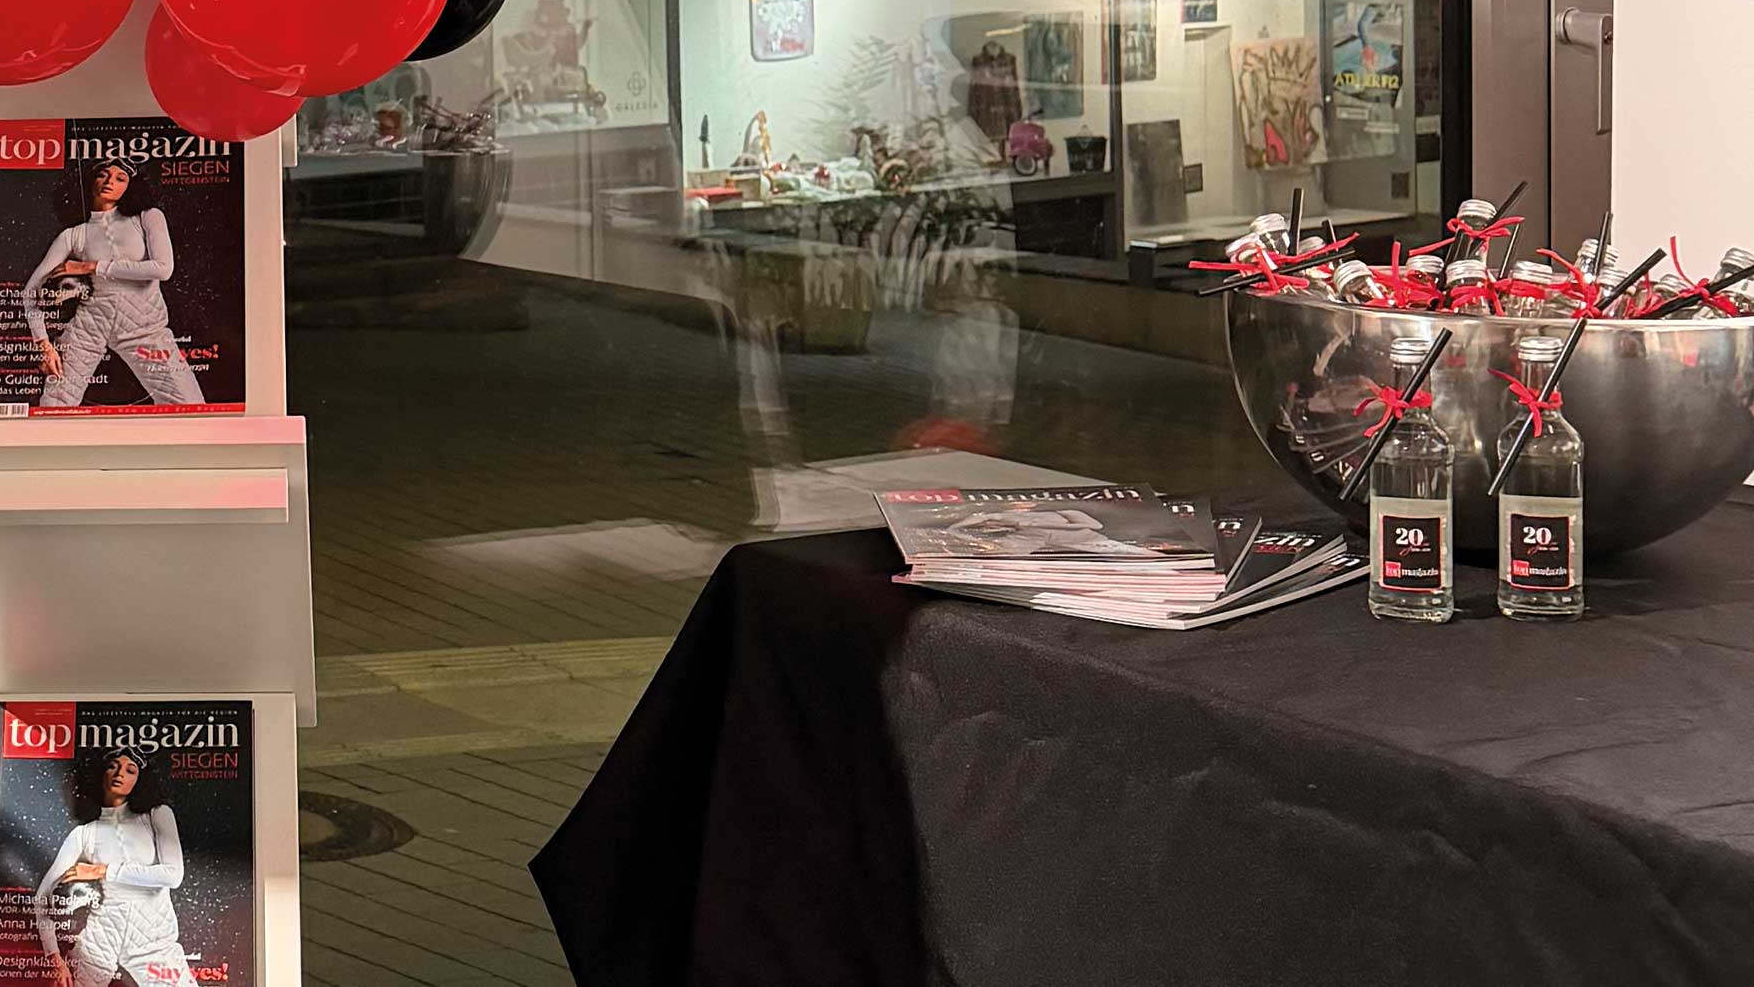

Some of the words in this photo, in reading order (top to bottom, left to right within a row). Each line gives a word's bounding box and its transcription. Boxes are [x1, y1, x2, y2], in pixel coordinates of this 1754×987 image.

[0, 134, 61, 165] top
[68, 132, 232, 164] magazin
[160, 161, 230, 176] SIEGEN
[6, 374, 43, 385] Guide:
[1396, 527, 1424, 546] 20
[1522, 526, 1552, 545] 20
[9, 718, 72, 753] top
[78, 716, 239, 754] magazin
[170, 752, 238, 769] SIEGEN
